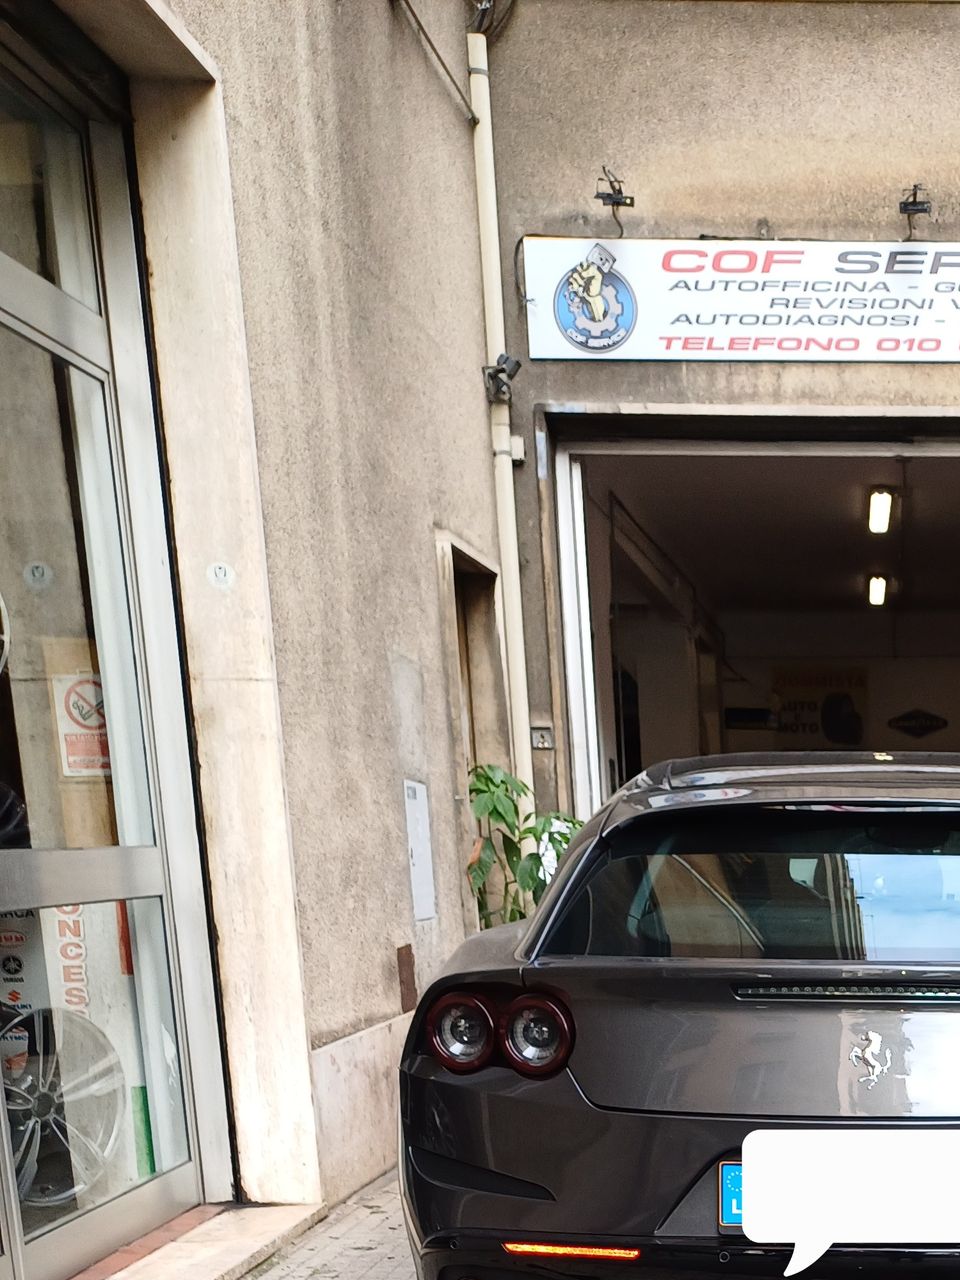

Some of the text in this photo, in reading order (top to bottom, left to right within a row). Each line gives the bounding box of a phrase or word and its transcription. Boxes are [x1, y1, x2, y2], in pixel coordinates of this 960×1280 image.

[661, 249, 805, 274] COF
[668, 279, 891, 293] AUTOFFICINA
[769, 297, 934, 310] REVISIONI
[669, 313, 920, 327] AUTODIAGNOSI
[658, 336, 860, 352] TELEFONO
[876, 337, 942, 352] 010
